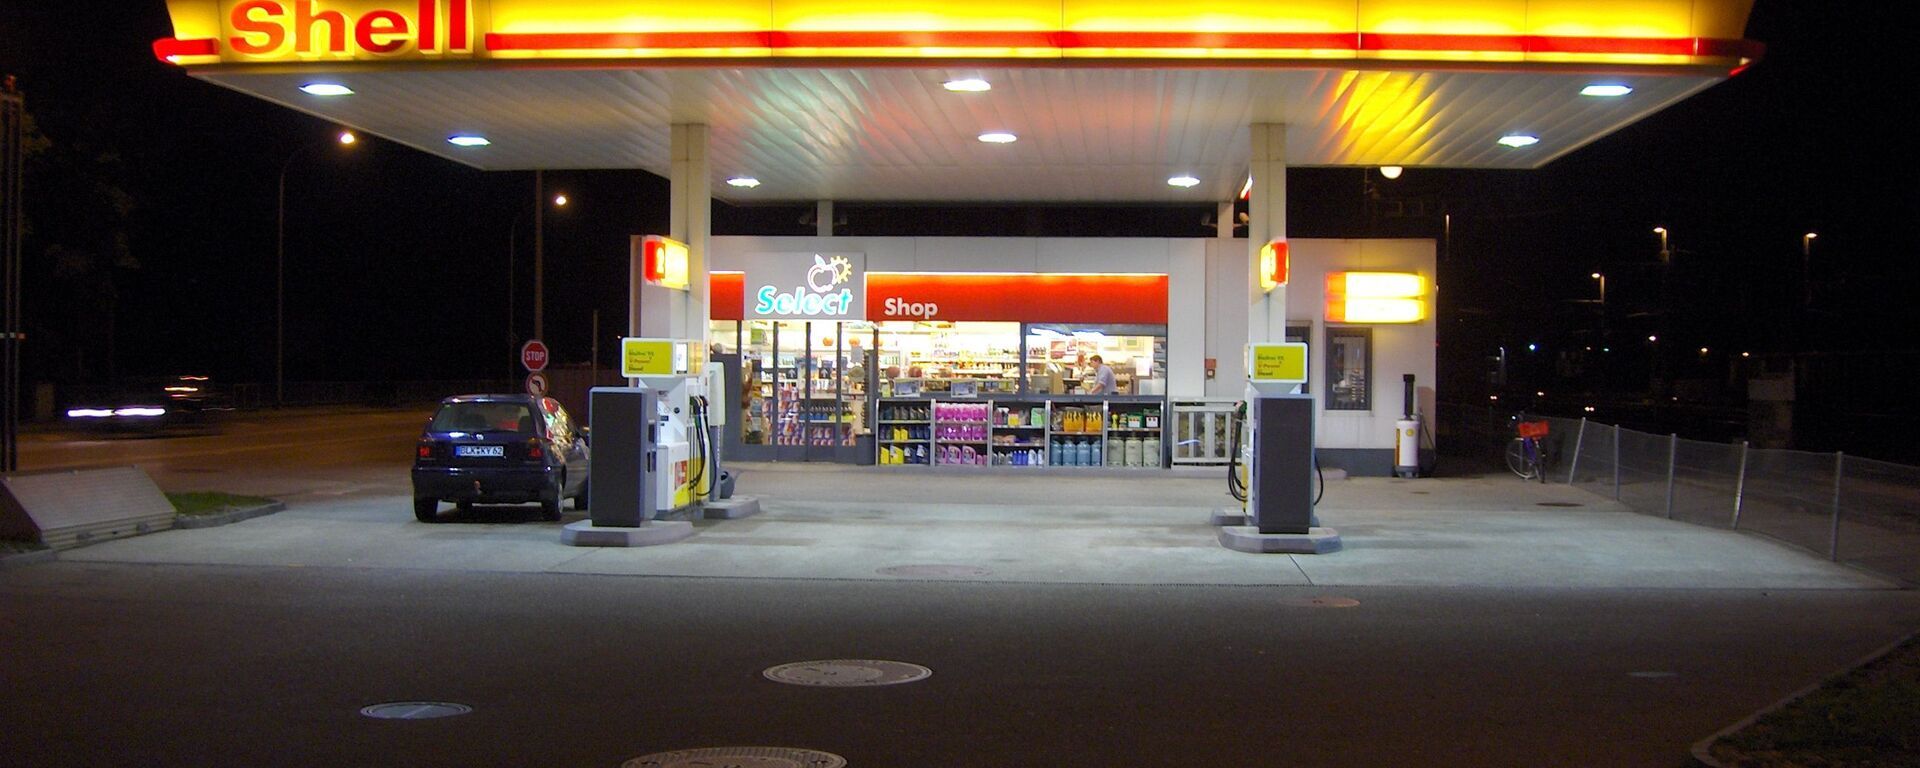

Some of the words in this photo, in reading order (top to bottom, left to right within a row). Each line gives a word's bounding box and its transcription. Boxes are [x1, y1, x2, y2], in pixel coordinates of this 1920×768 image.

[229, 0, 468, 55] Shell
[755, 285, 853, 316] Select
[884, 297, 938, 319] Shop
[526, 351, 545, 361] STOP
